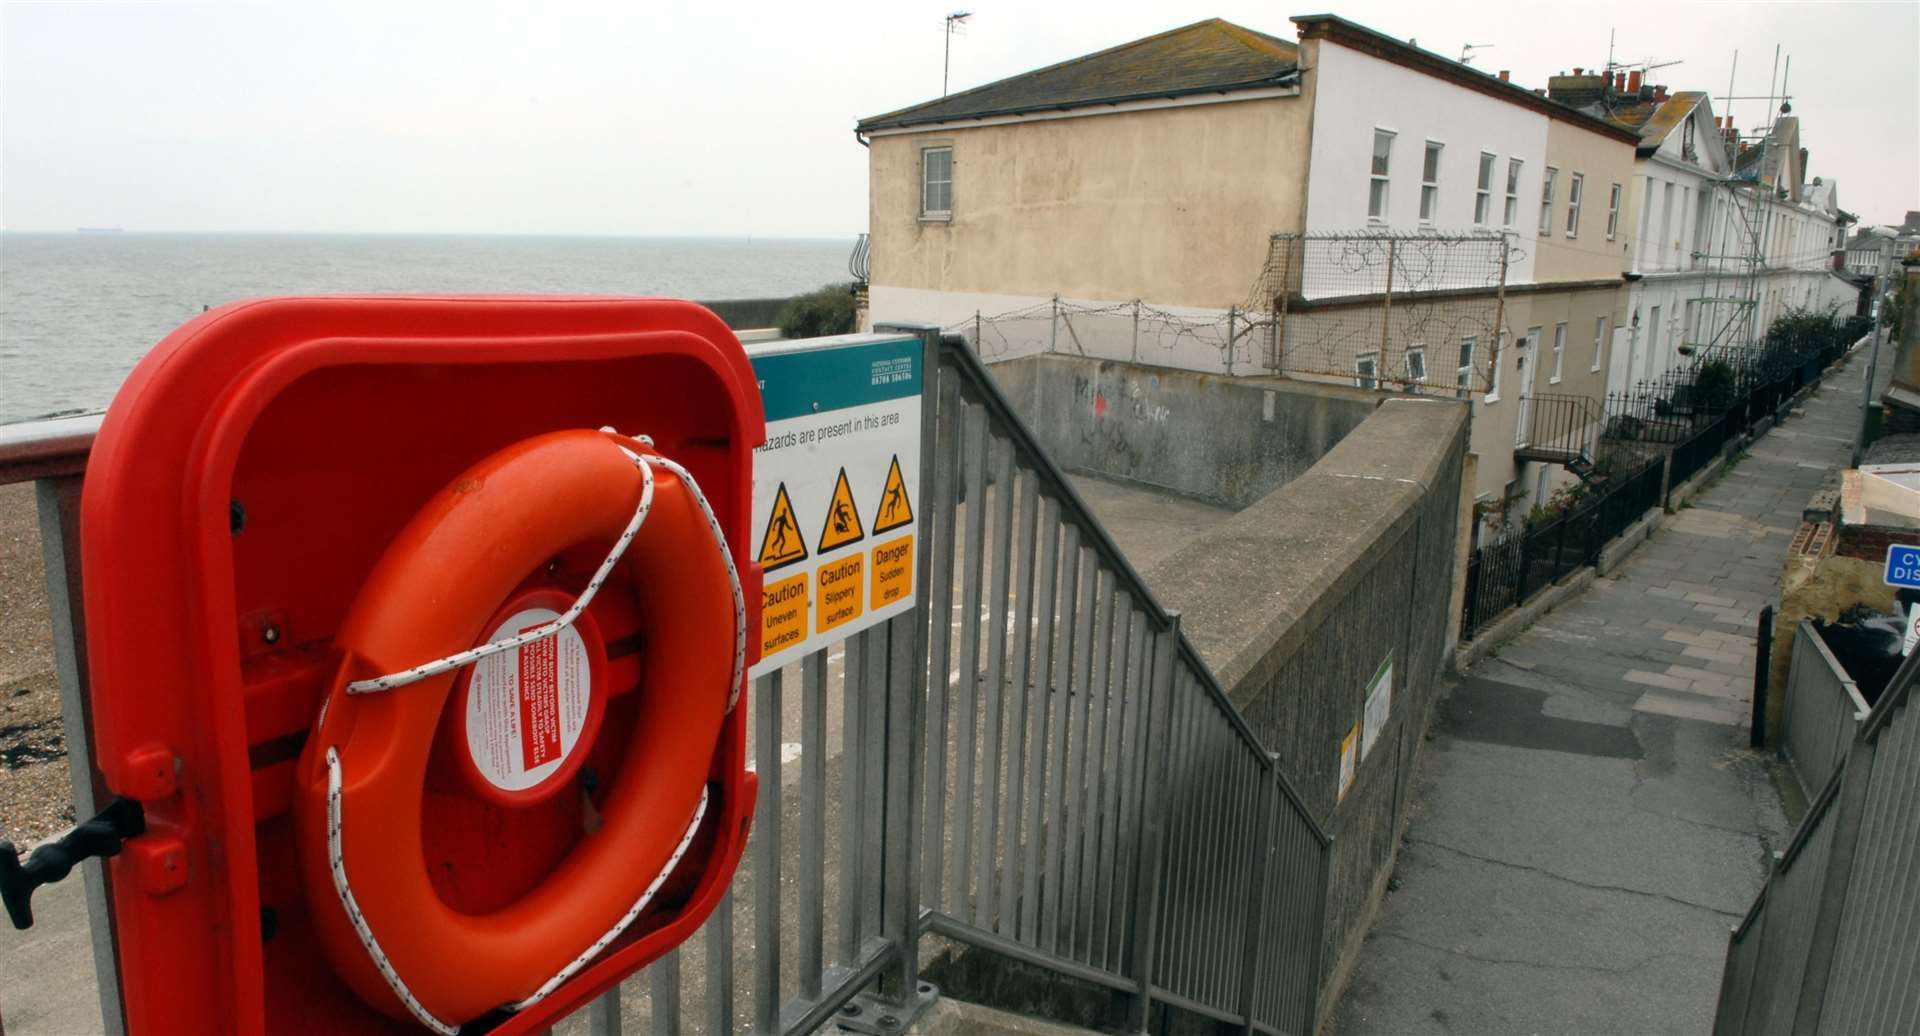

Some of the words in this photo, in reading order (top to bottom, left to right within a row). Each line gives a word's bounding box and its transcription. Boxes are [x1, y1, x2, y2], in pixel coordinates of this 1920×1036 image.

[800, 430, 814, 444] are
[818, 422, 852, 444] present
[854, 418, 862, 430] in
[864, 414, 879, 430] this
[881, 412, 900, 426] area
[876, 543, 909, 566] Danger
[820, 561, 860, 586] Caution
[880, 566, 904, 584] Sudden
[762, 583, 804, 609] Caution
[825, 586, 855, 606] Slippery
[884, 587, 899, 600] drop
[766, 608, 798, 628] Uneven
[826, 604, 854, 625] surface
[764, 628, 800, 650] surfaces
[509, 673, 514, 686] TO
[538, 719, 544, 730] TO
